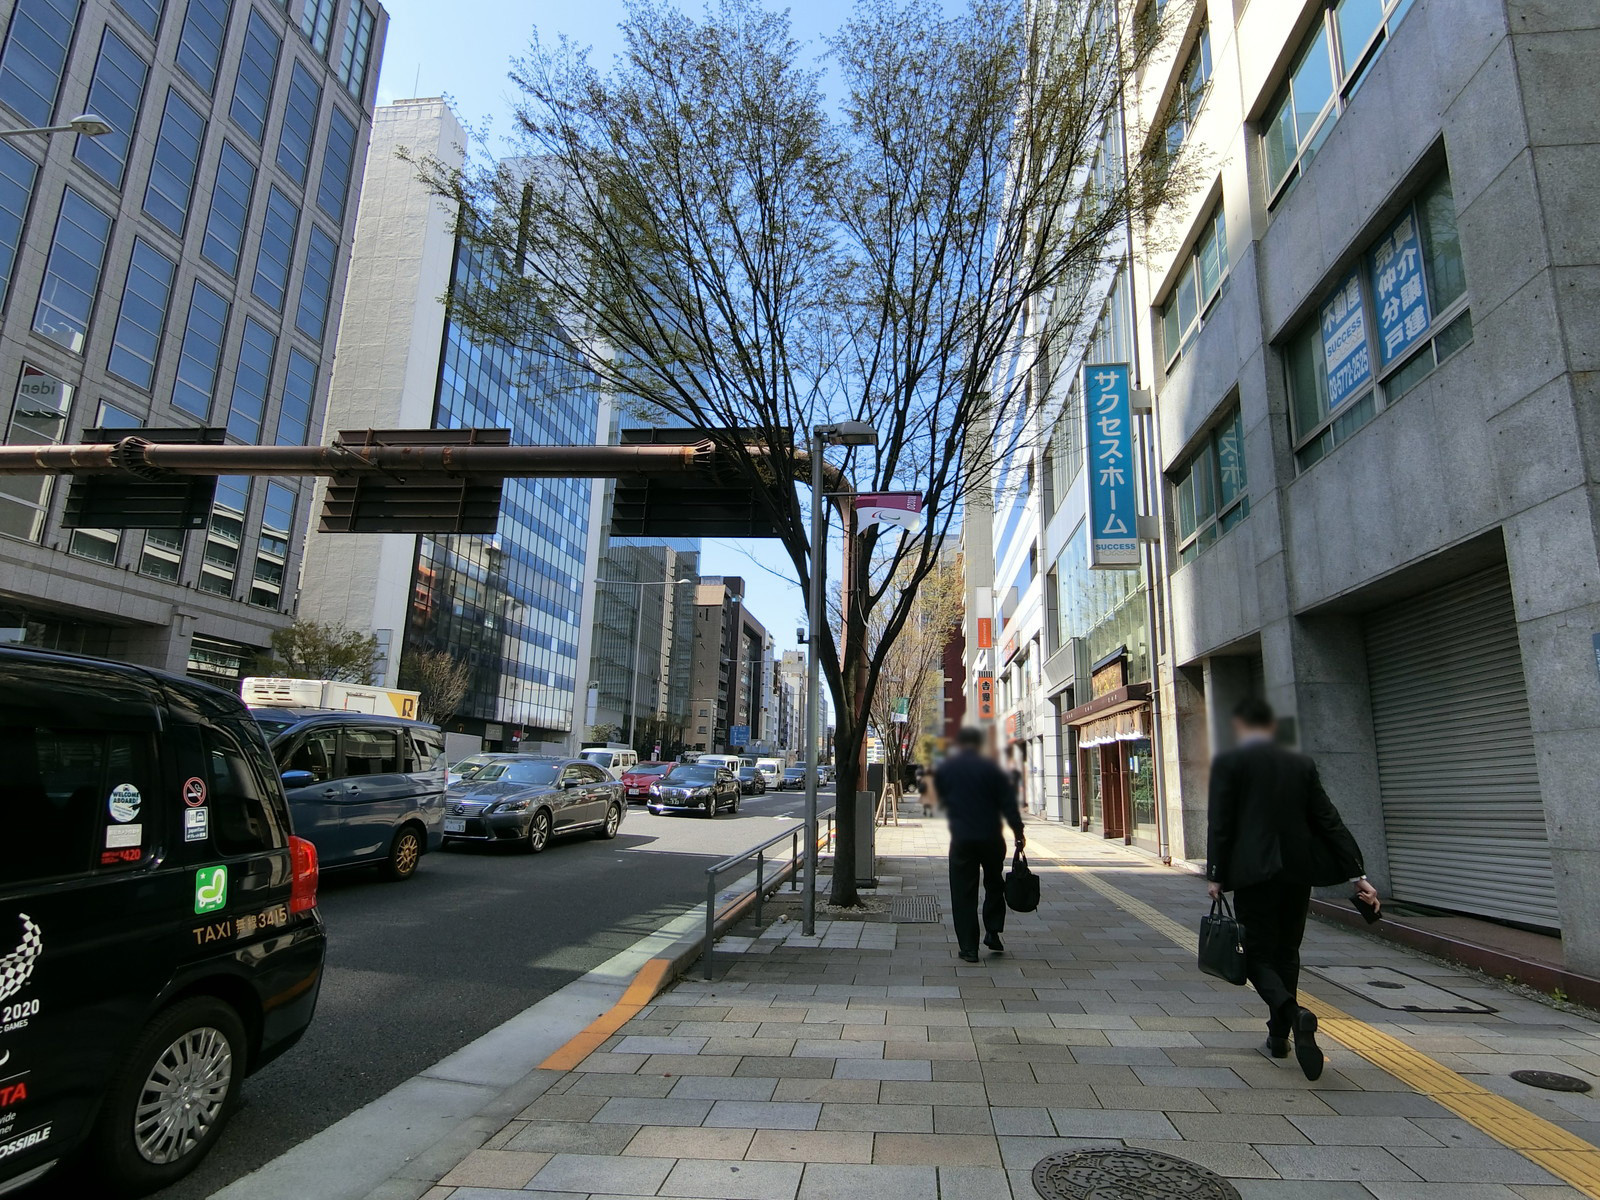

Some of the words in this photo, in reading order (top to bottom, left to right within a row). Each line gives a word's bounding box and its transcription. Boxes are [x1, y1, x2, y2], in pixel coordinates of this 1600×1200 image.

[1378, 248, 1417, 300] 仲介
[1323, 275, 1360, 333] 不動産
[1382, 272, 1422, 329] 分譲
[1327, 316, 1362, 358] SUCCESS
[1385, 305, 1426, 358] 戸建
[1094, 370, 1128, 534] サクセス・ホーム
[193, 921, 231, 944] TAXI
[3, 999, 40, 1023] 2020
[4, 1018, 29, 1032] GAMES
